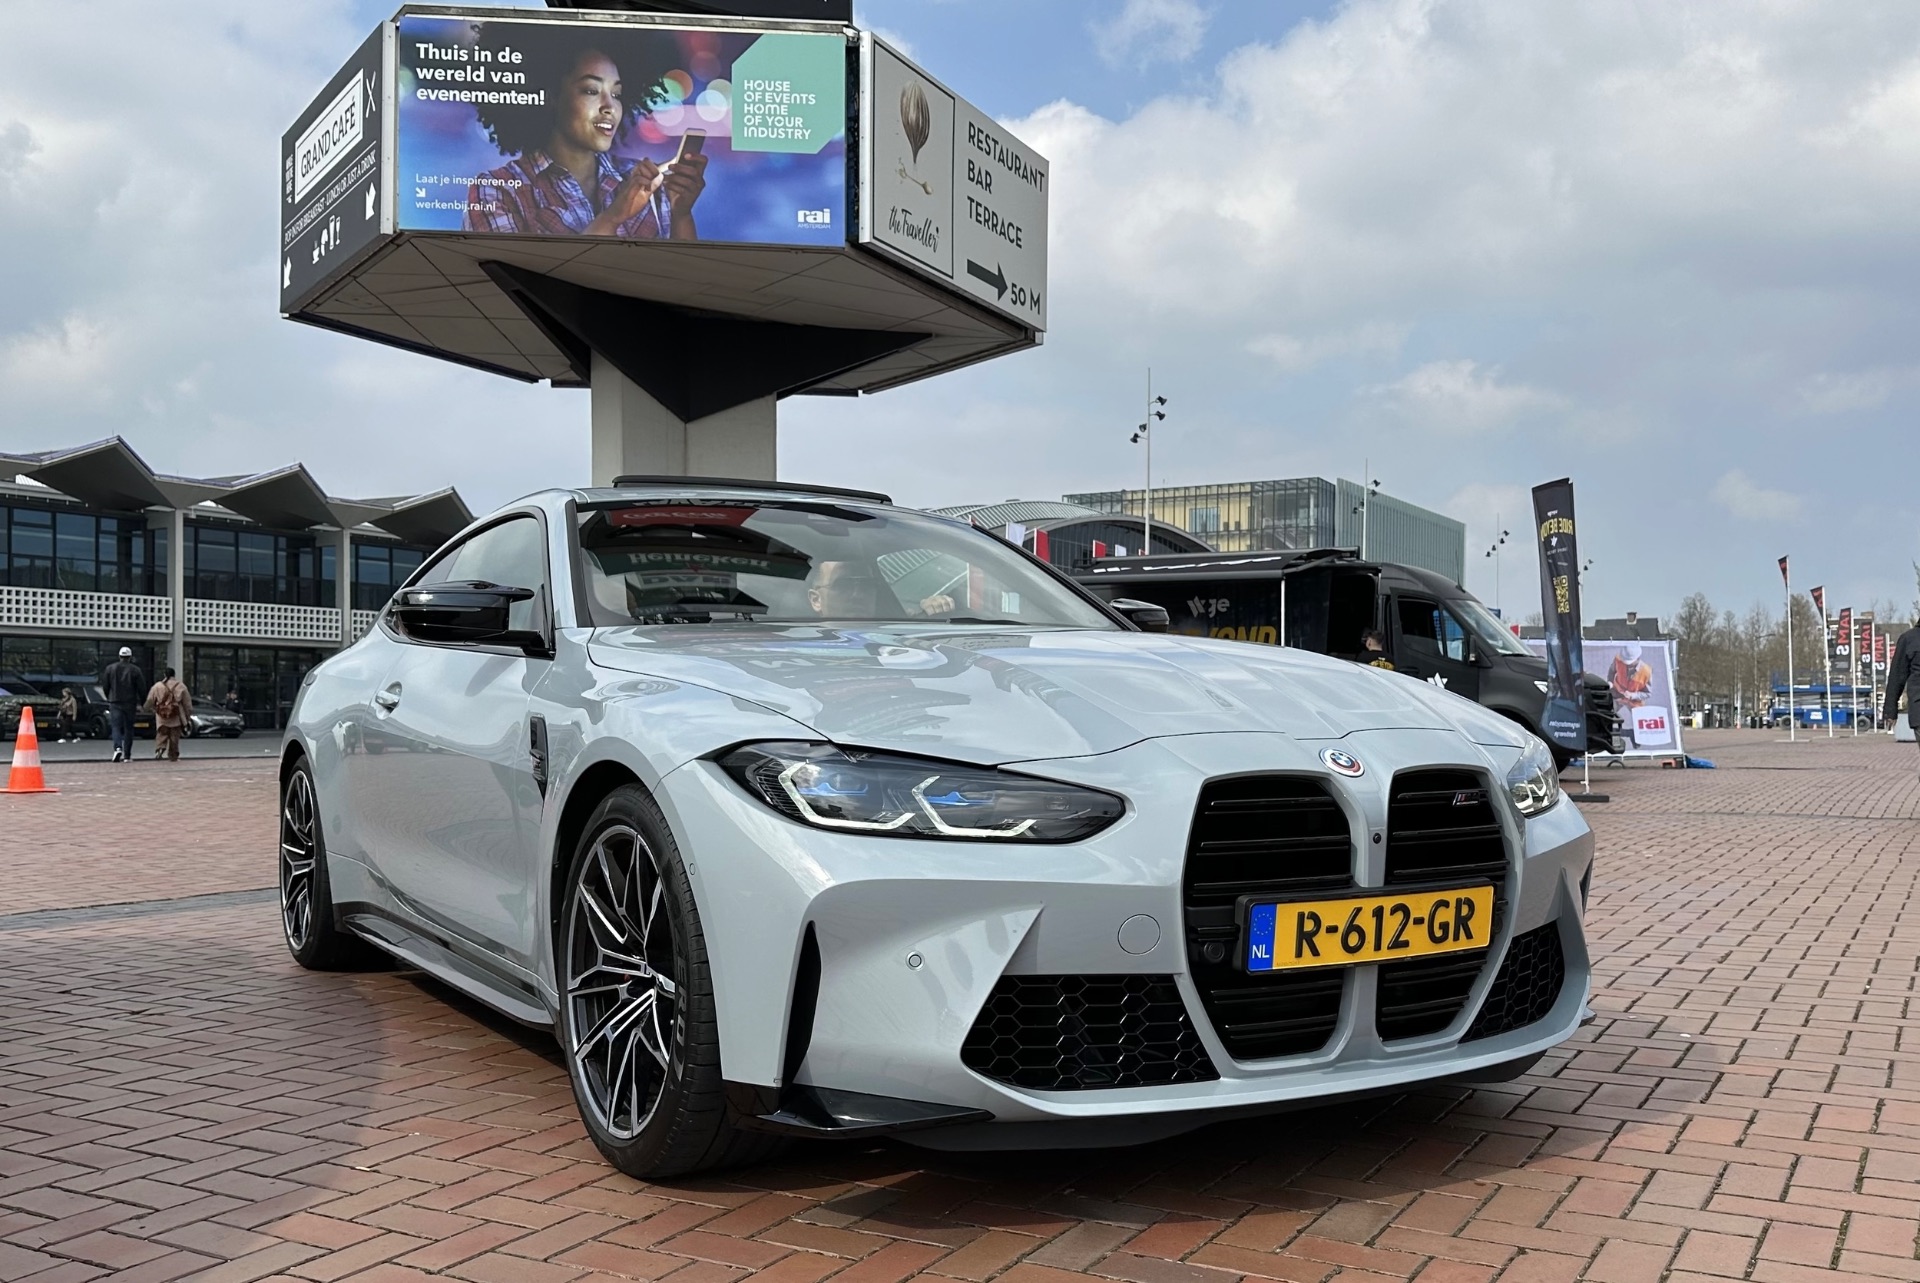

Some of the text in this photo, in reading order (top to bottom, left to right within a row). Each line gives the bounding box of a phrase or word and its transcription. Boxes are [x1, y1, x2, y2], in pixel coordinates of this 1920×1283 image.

[415, 43, 523, 64] Thuis in de
[415, 65, 526, 84] wereld van
[743, 80, 791, 92] HOUSE
[416, 88, 545, 105] evenementen!
[743, 91, 816, 105] OF EVENTS
[743, 103, 788, 115] HOME
[743, 115, 804, 128] OF YOUR
[301, 95, 356, 178] GRAND CAFÉ
[743, 126, 812, 140] INDUSTRY
[968, 120, 1045, 192] RESTAURANT
[415, 173, 522, 189] Laat je inspireren op
[967, 158, 993, 194] BAR
[415, 199, 496, 212] werkenbij.rai.nl
[797, 208, 831, 223] rai
[966, 195, 1023, 249] TERRACE
[1010, 282, 1041, 315] 50 M
[1638, 716, 1665, 730] rai
[1294, 896, 1476, 958] R-612-GR
[1251, 943, 1270, 959] NL
